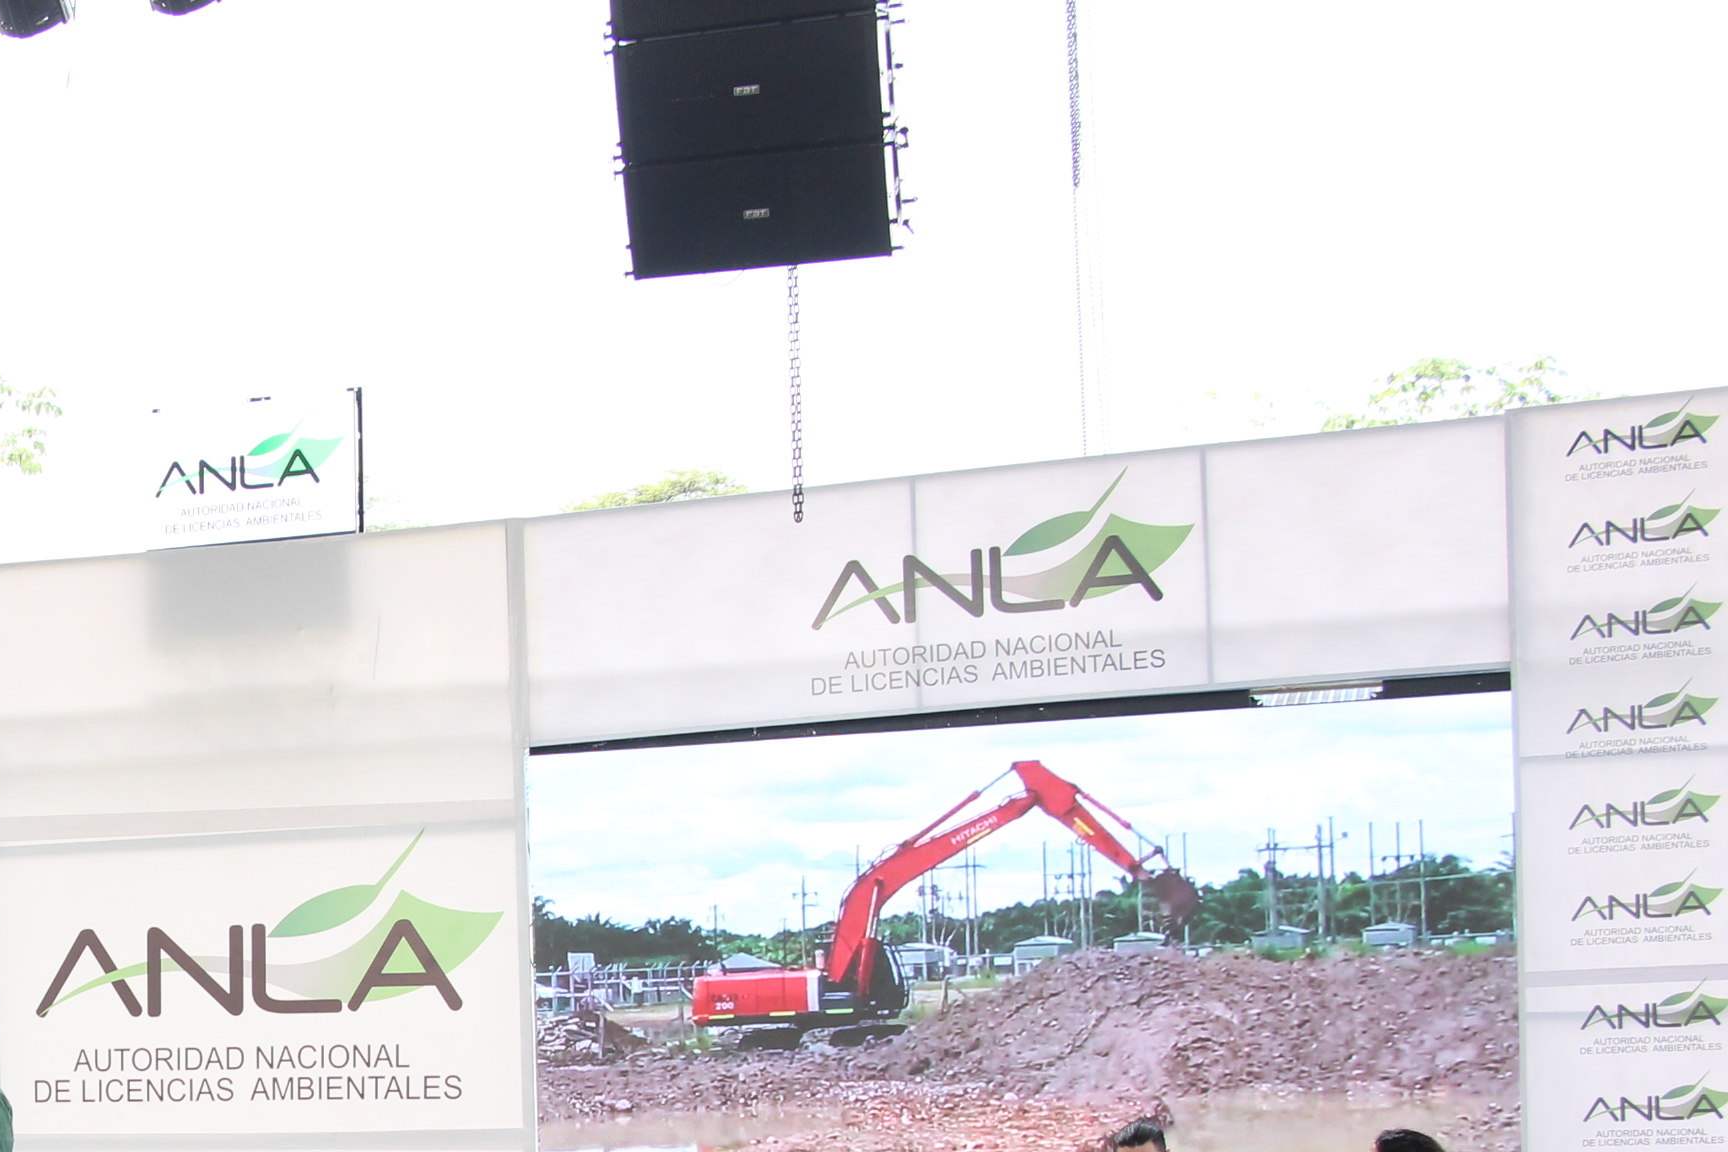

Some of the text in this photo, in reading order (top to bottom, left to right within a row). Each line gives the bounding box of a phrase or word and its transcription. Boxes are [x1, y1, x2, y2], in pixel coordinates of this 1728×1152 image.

[1565, 417, 1707, 457] ANLA
[156, 448, 320, 498] ANLA
[1565, 460, 1707, 482] DE LICENCIAS AMBIENTALES
[1578, 453, 1690, 471] AUTORIDAD NACIONAL
[181, 497, 303, 517] AUTORIDAD NACIONAL
[165, 510, 323, 534] DE LICENCIAS AMBIENTALES
[1568, 510, 1709, 549] ANLA
[1567, 553, 1709, 573] DE LICENCIAS AMBIENTALES
[1580, 546, 1692, 563] AUTORIDAD NACIONAL
[810, 530, 1164, 631] ANLA
[1570, 604, 1711, 641] ANLA
[844, 628, 1122, 670] AUTORIDAD NACIONAL
[1569, 647, 1711, 665] DE LICENCIAS AMBIENTALES
[1582, 639, 1694, 655] AUTORIDAD NACIONAL
[812, 648, 1166, 696] DE LICENCIAS AMBIENTALES
[1566, 699, 1706, 734] ANLA
[1565, 742, 1707, 759] DE LICENCIAS AMBIENTALES
[1578, 734, 1690, 749] AUTORIDAD NACIONAL
[1568, 796, 1709, 830] ANLA
[951, 815, 998, 845] HITACHI
[1581, 832, 1692, 845] AUTORIDAD NACIONAL
[1568, 839, 1709, 855] DE LICENCIAS AMBIENTALES
[1571, 889, 1711, 922] ANLA
[1570, 932, 1712, 946] DE LICENCIAS AMBIENTALES
[1583, 924, 1695, 936] AUTORIDAD NACIONAL
[36, 918, 463, 1018] ANLA
[715, 1002, 734, 1010] 200
[1580, 999, 1721, 1030] ANLA
[1579, 1042, 1721, 1055] DE LICENCIAS AMBIENTALES
[1593, 1034, 1704, 1045] AUTORIDAD NACIONAL
[73, 1044, 410, 1072] AUTORIDAD NACIONAL
[34, 1075, 463, 1104] DE LICENCIAS AMBIENTALES
[1582, 1093, 1724, 1122] ANLA
[1582, 1136, 1724, 1147] DE LICENCIAS AMBIENTALES
[1595, 1127, 1707, 1138] AUTORIDAD NACIONAL
